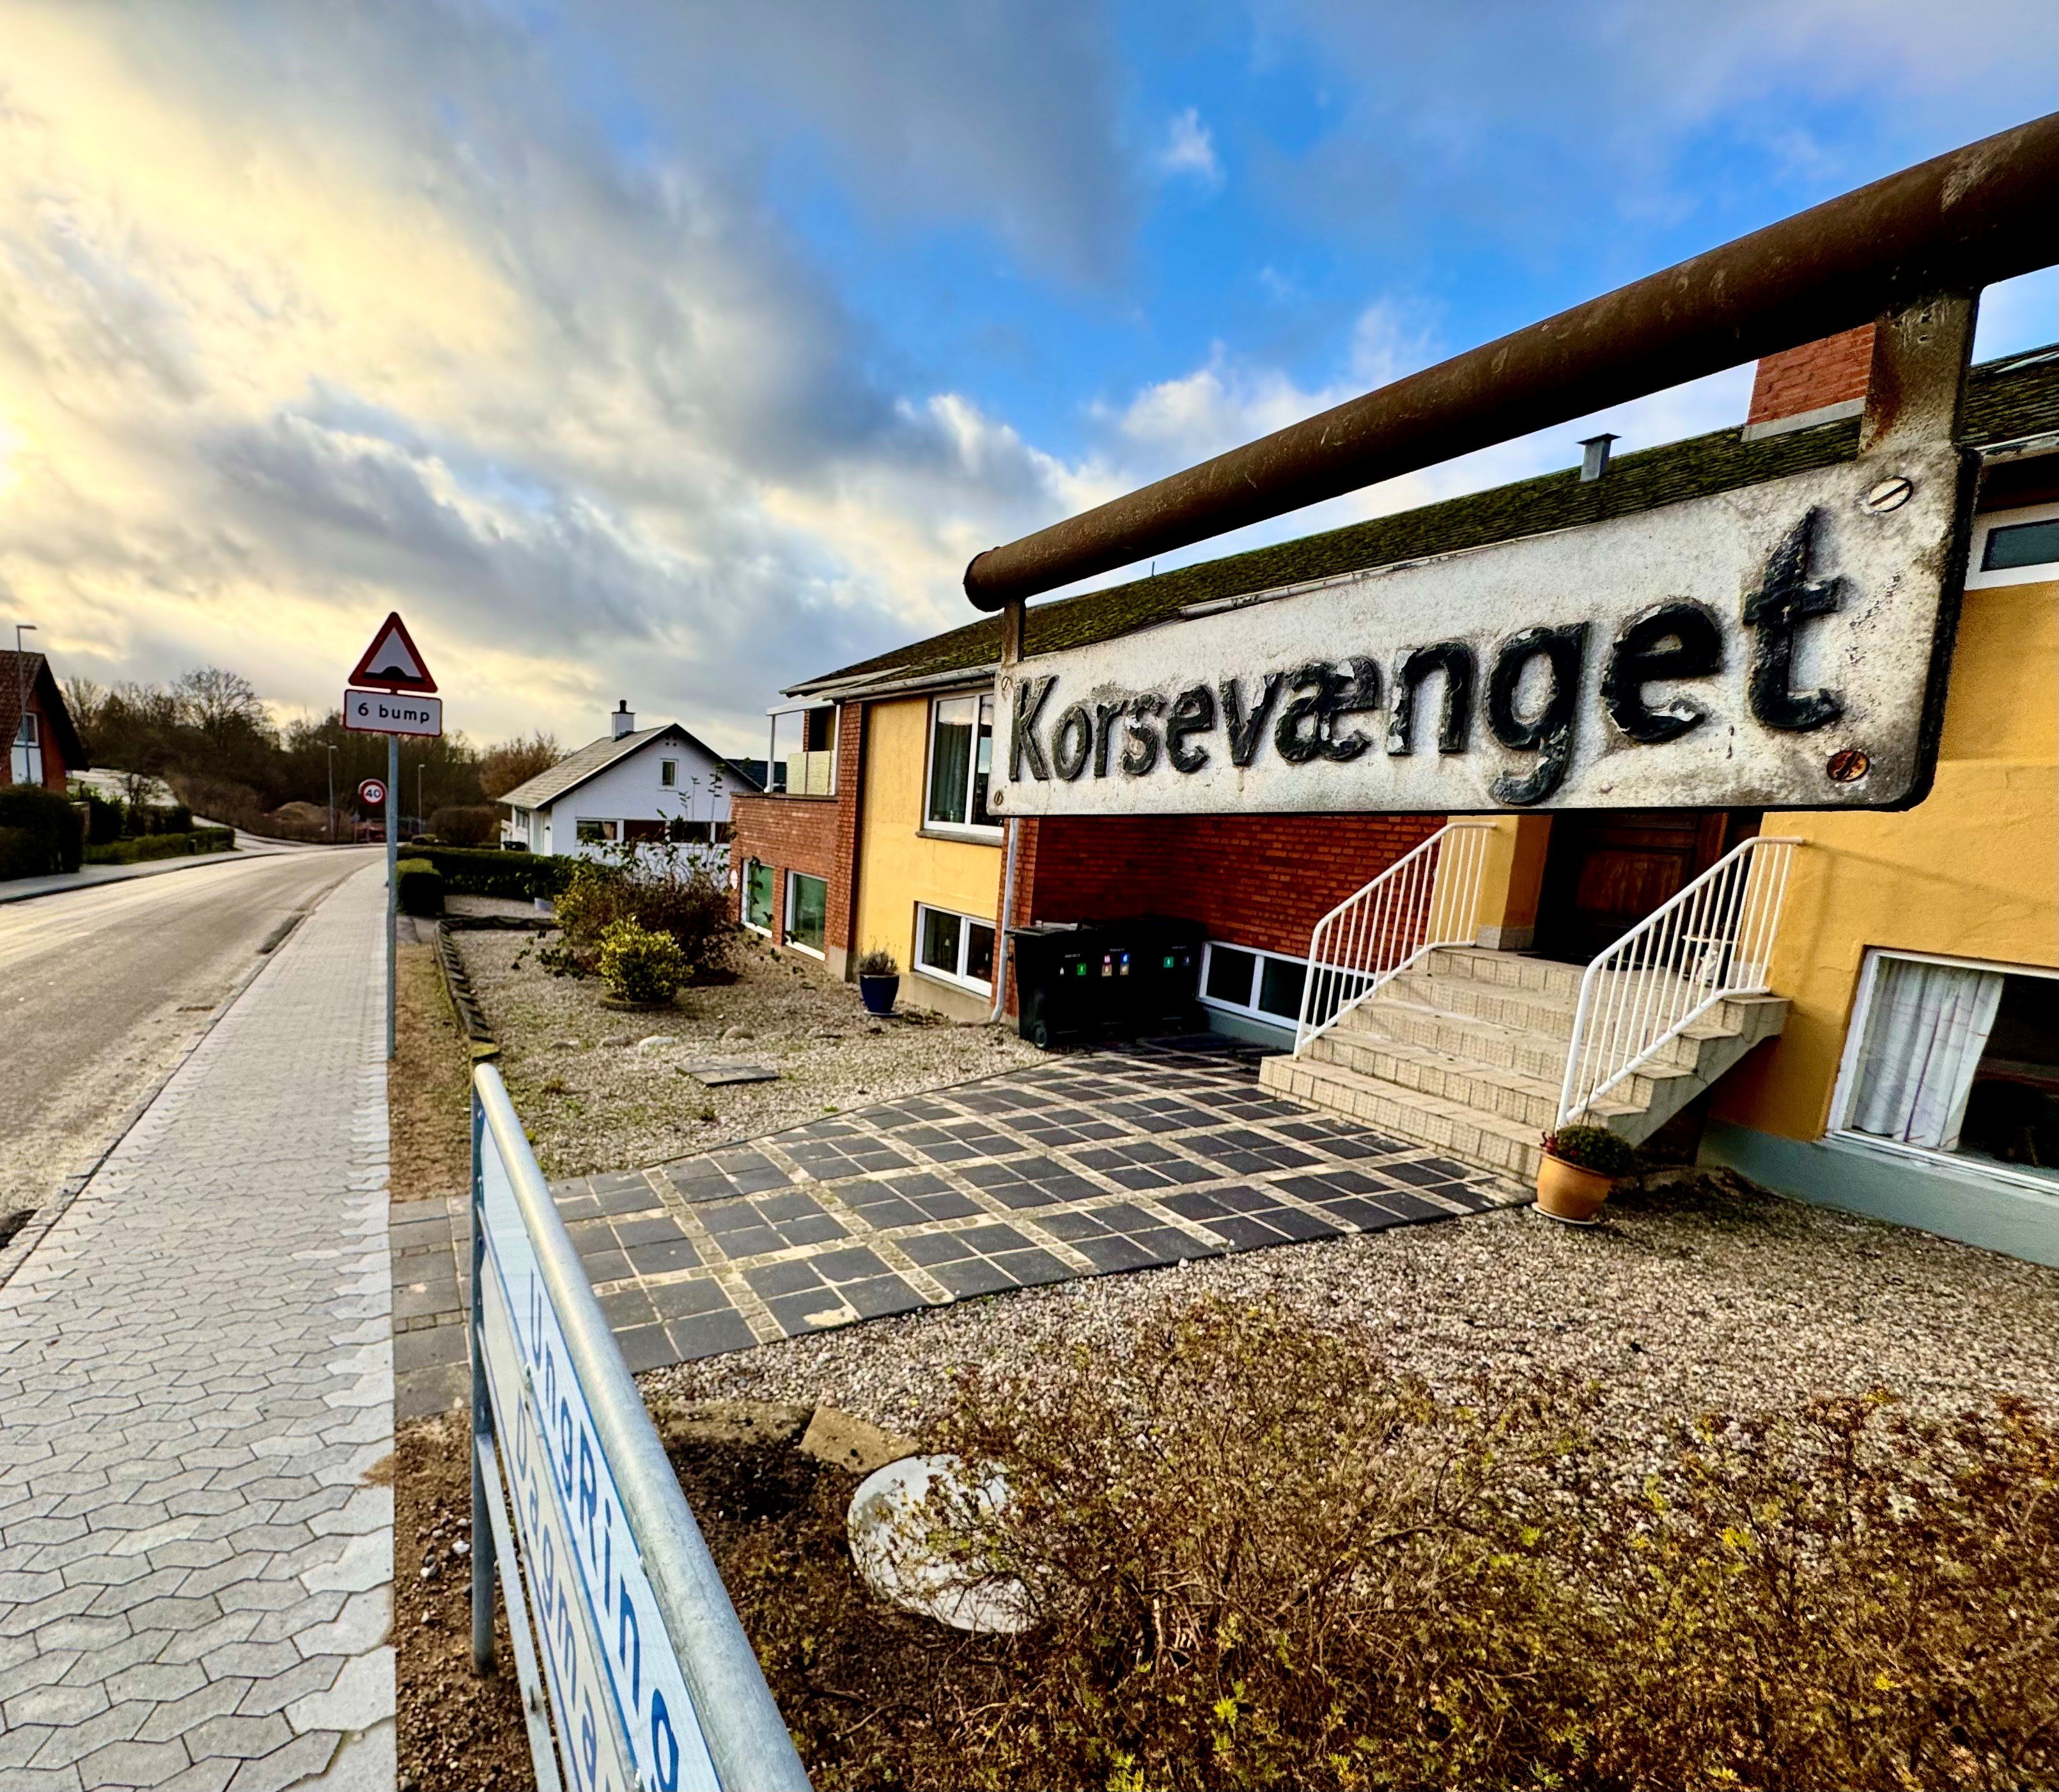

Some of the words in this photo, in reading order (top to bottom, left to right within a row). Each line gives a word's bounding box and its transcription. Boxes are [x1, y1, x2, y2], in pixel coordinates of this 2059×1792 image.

[1009, 506, 1843, 806] Korsevænget
[358, 703, 369, 716] 6
[380, 705, 430, 723] bump
[366, 790, 381, 798] 40
